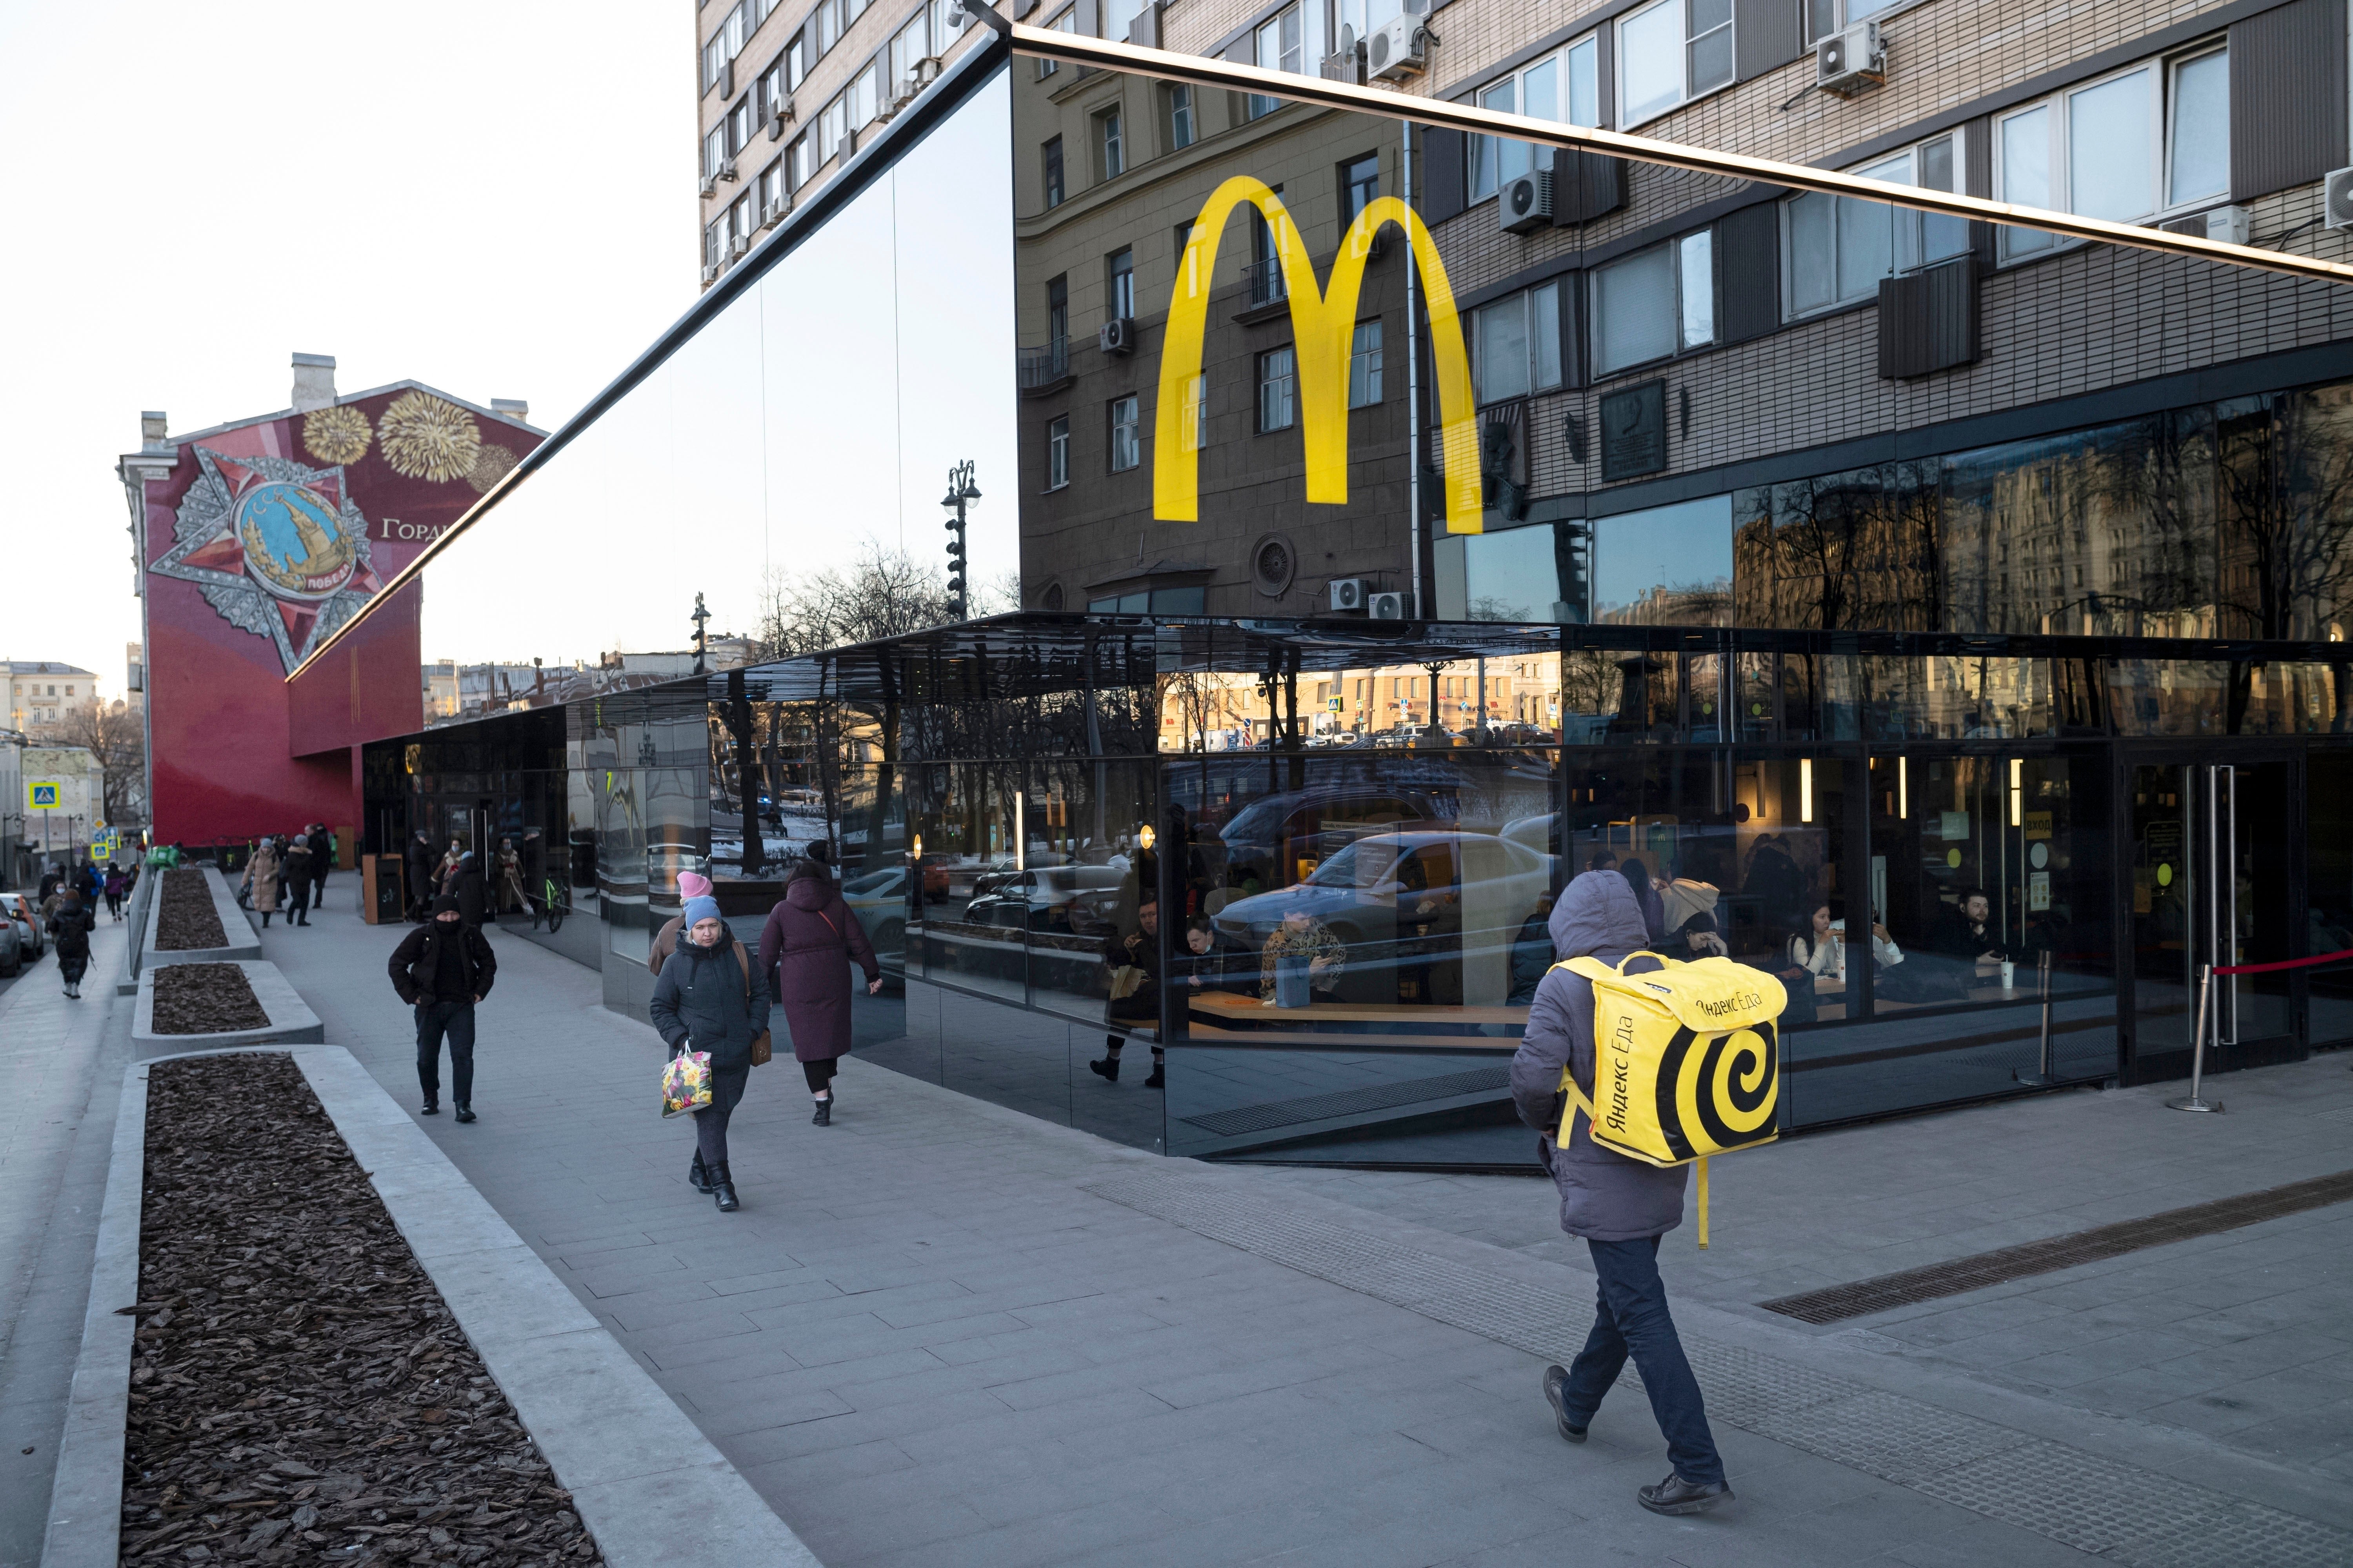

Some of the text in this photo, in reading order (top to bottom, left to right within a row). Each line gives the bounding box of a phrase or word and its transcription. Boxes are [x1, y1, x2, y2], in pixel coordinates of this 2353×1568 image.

[307, 564, 350, 589] ПОБЕДА
[2027, 820, 2051, 832] ВХОД
[1696, 992, 1762, 1017] Яндекс Еда
[1606, 1016, 1634, 1134] Яндекс Еда
